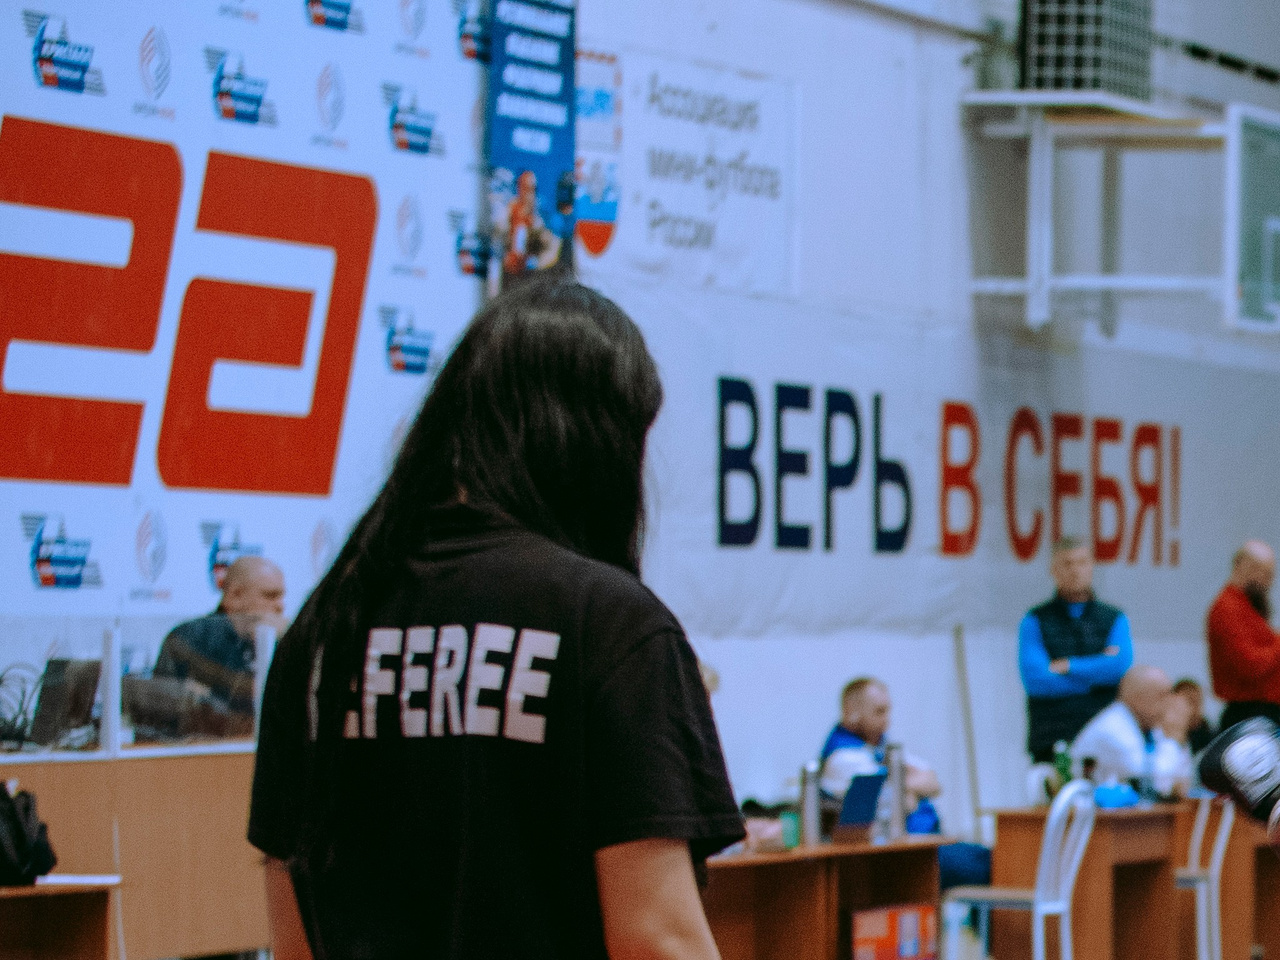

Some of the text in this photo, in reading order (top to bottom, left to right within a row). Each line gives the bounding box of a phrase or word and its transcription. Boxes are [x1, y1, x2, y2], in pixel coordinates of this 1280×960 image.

[717, 376, 1182, 567] ВЕРЬ В СЕБЯ!
[307, 622, 561, 743] FEREE
